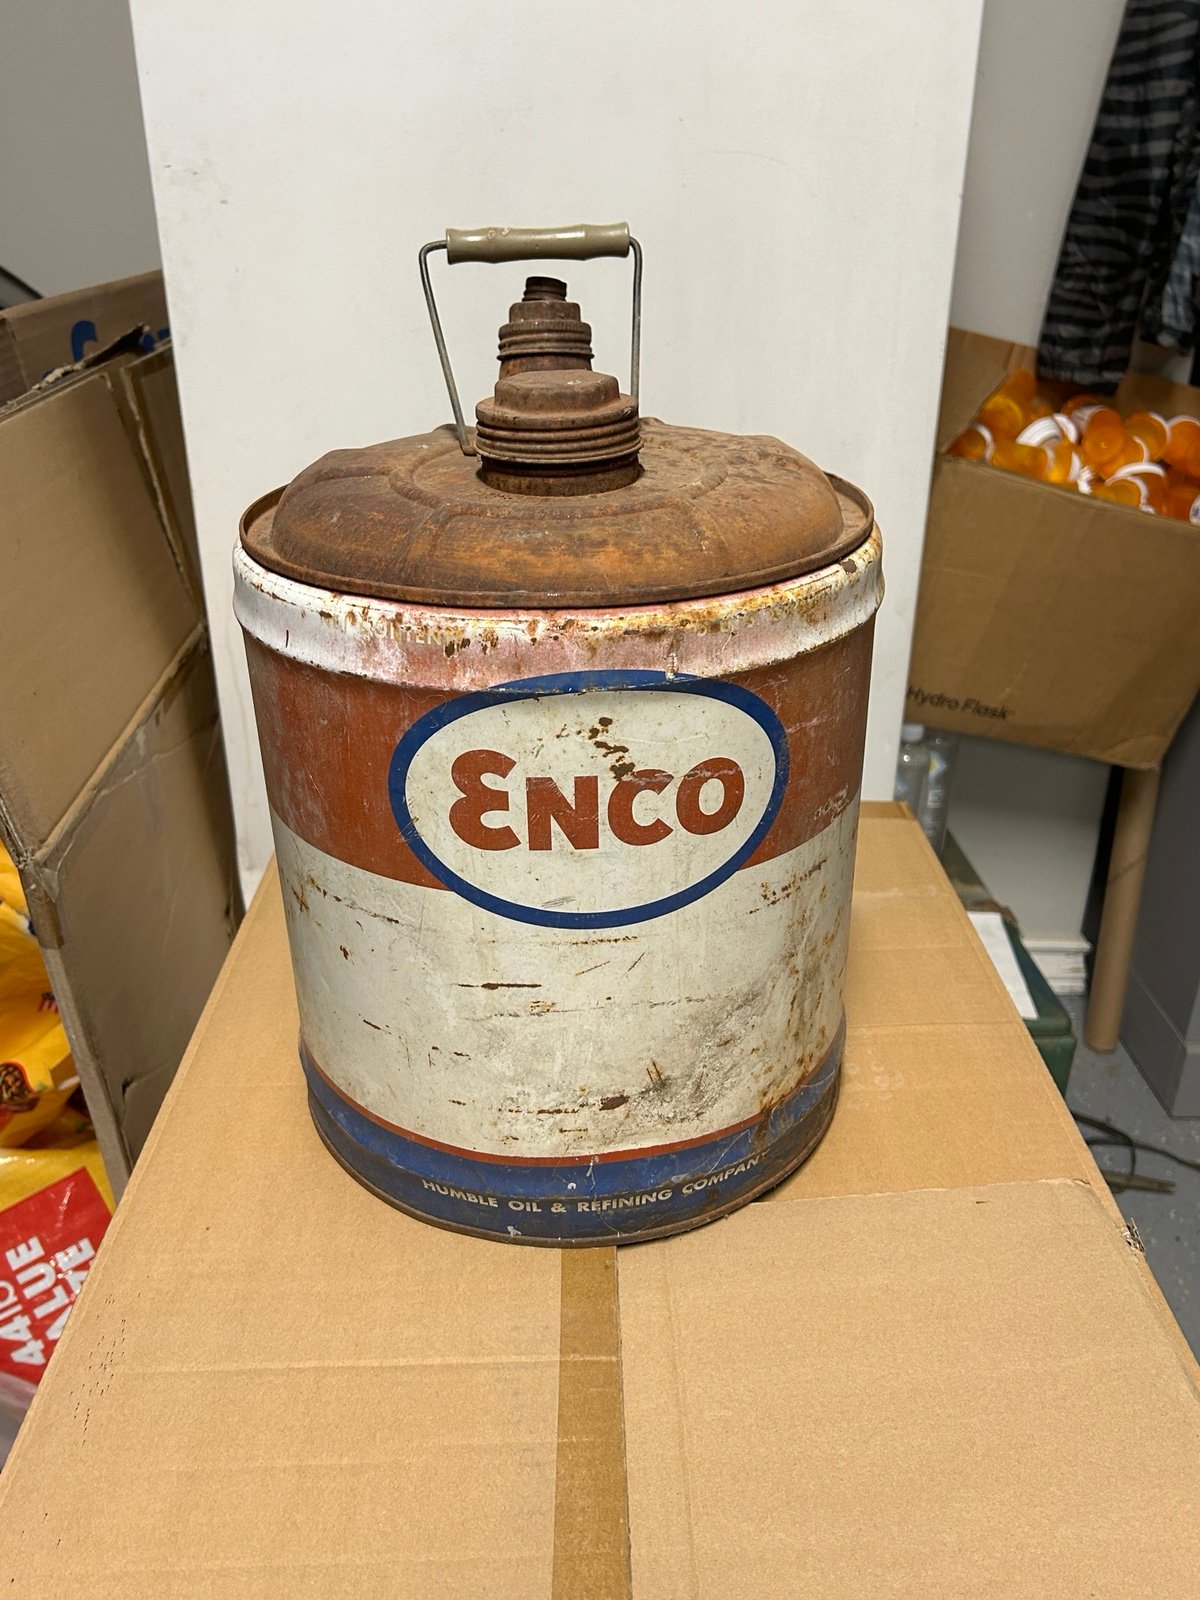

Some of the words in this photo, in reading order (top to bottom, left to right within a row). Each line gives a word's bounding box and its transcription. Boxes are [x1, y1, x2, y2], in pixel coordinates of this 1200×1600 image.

[907, 685, 959, 712] Hydro
[960, 698, 1008, 721] Flask
[449, 748, 746, 852] ENCO
[422, 1178, 498, 1207] HUMBLE
[508, 1200, 542, 1213] OIL
[550, 1201, 567, 1213] &
[577, 1188, 673, 1213] REFINING
[5, 1235, 73, 1340] ALUE
